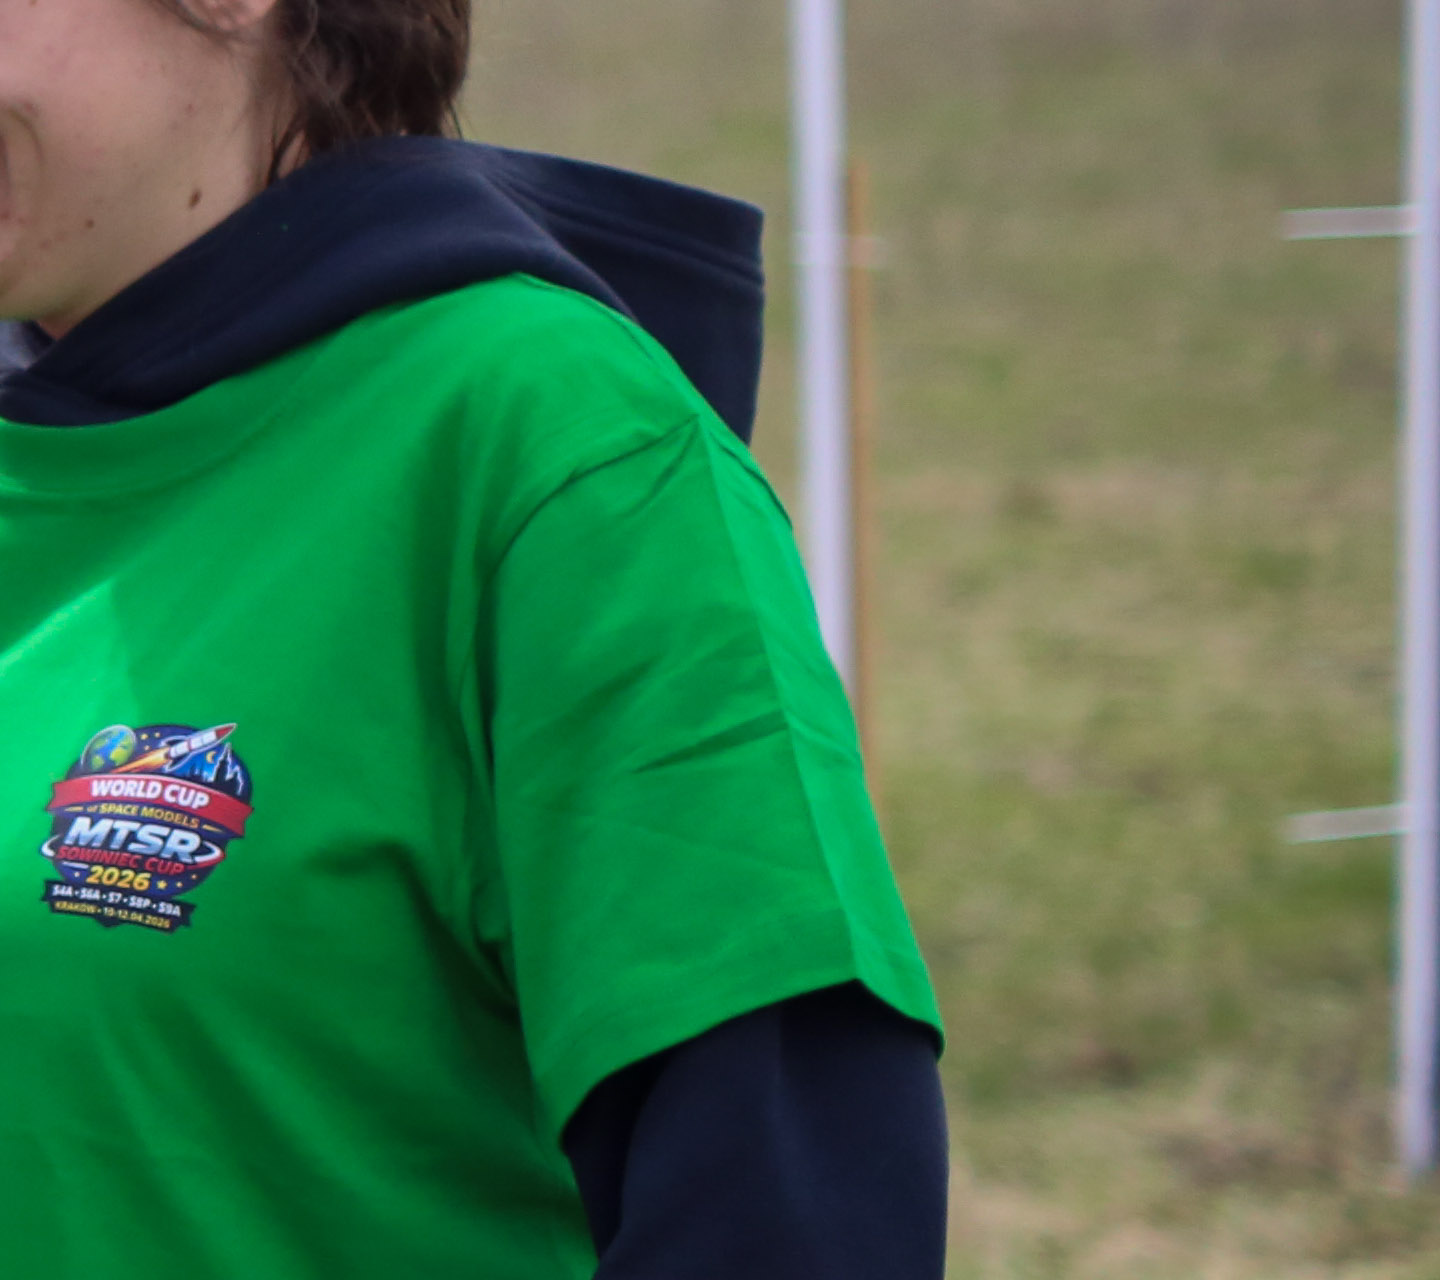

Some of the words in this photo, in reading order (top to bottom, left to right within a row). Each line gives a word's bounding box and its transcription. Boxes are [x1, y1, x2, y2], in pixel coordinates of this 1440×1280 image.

[91, 779, 163, 799] WORLD
[164, 784, 210, 810] CUP
[99, 803, 139, 817] SPACE
[141, 806, 200, 829] MODELS
[64, 816, 201, 864] MTSR
[56, 845, 143, 869] SOWINIEC
[144, 857, 186, 876] CUP
[85, 865, 152, 892] 2026
